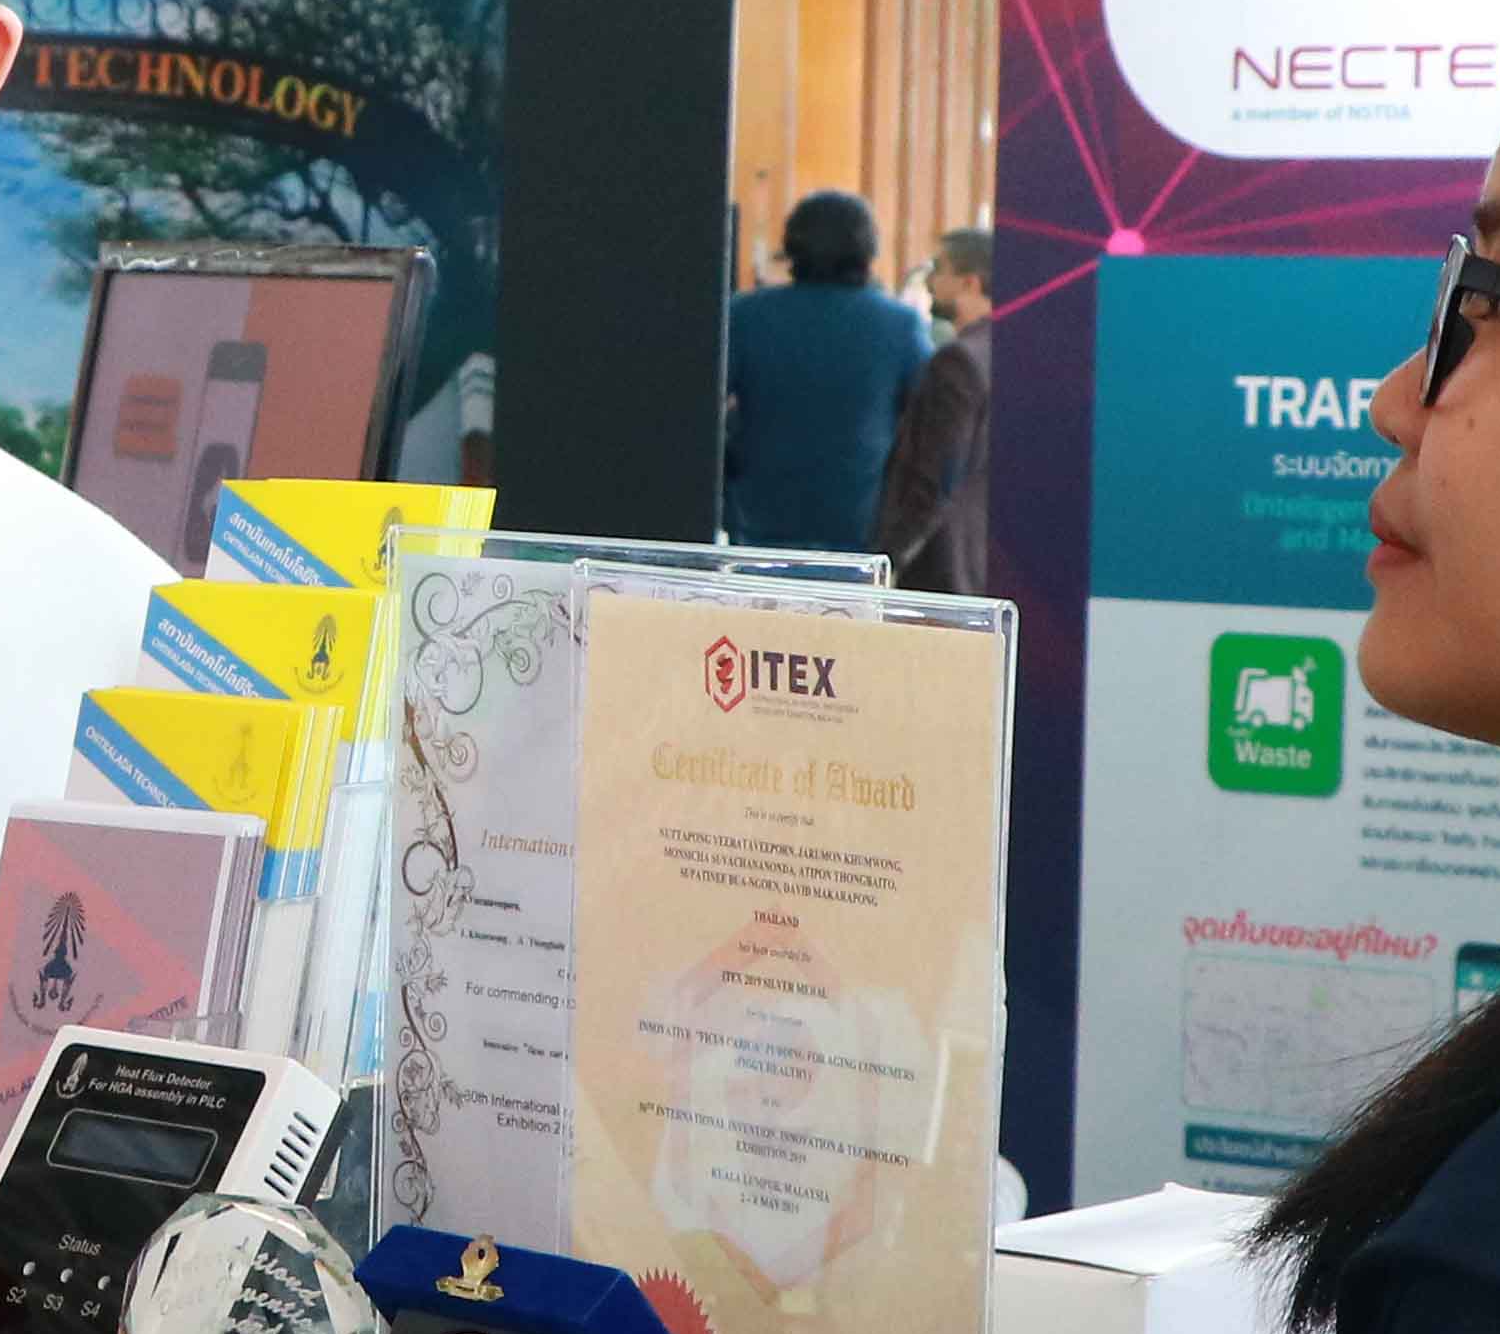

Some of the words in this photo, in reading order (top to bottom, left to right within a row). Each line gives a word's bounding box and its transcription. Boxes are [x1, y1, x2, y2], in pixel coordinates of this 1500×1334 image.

[31, 43, 367, 139] TECHNOLOGY
[750, 649, 837, 699] ITEX
[1233, 739, 1312, 770] Waste
[651, 740, 785, 797] Certificate
[824, 761, 917, 813] Award
[753, 910, 800, 928] THAILAND
[465, 981, 486, 999] For
[487, 985, 560, 1010] commending
[88, 1076, 107, 1091] For
[108, 1080, 133, 1096] HGA
[134, 1087, 185, 1106] assembly
[185, 1092, 198, 1104] in
[114, 1064, 141, 1081] Heat
[142, 1068, 166, 1084] Flux
[166, 1072, 213, 1090] Detector
[490, 1093, 561, 1117] International
[496, 1113, 553, 1134] Exhibition
[57, 1233, 101, 1256] Status
[6, 1285, 28, 1305] S2
[42, 1292, 65, 1312] S3
[80, 1299, 102, 1319] S4
